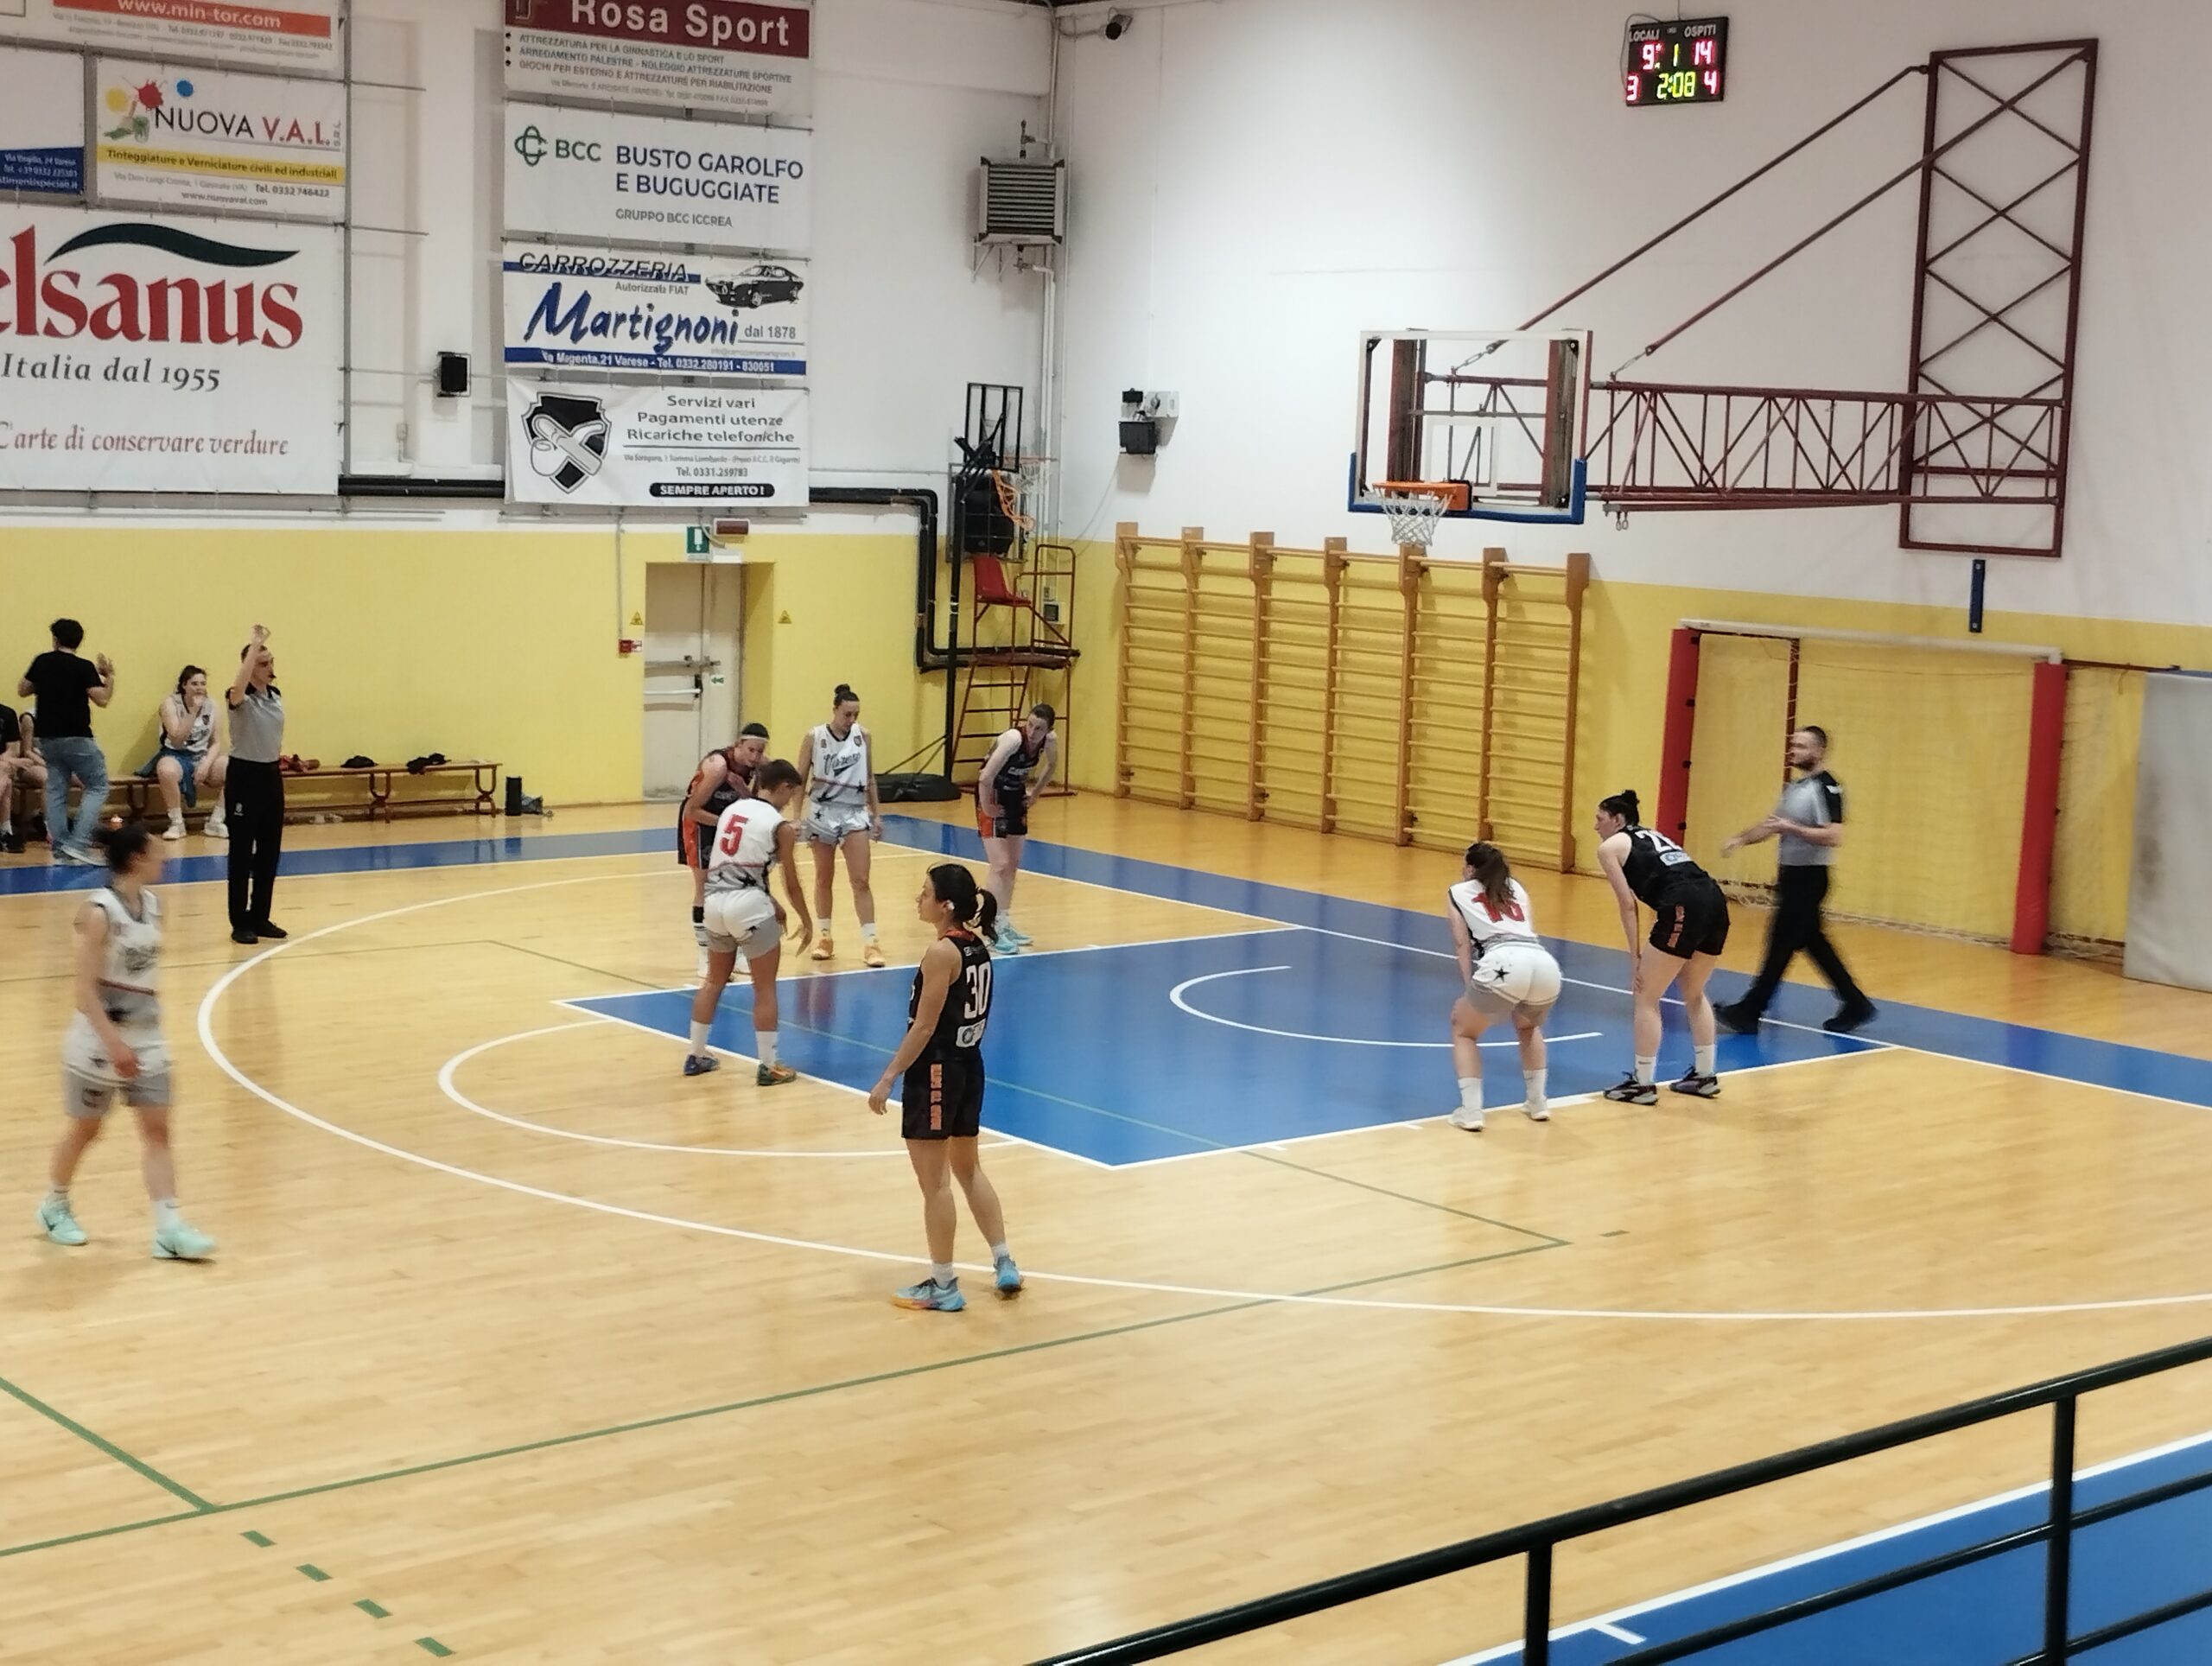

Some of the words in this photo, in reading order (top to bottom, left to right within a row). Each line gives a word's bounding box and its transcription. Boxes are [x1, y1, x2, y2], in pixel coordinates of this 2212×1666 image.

[572, 0, 668, 34] Rosa
[685, 3, 789, 46] Sport
[1629, 29, 1660, 42] LOCALI
[1684, 24, 1716, 37] OSPITI
[519, 35, 588, 49] ATTREZZATURA
[589, 42, 607, 52] PER
[610, 44, 620, 54] LA
[622, 46, 675, 60] GINNASTICA
[697, 54, 724, 65] SPORT
[519, 47, 588, 62] ARREDAMENTO
[590, 54, 633, 67] PALESTRE
[642, 60, 685, 73] NOLEGGIO
[687, 65, 751, 80] ATTREZZATURE
[753, 71, 791, 84] SPORTIVE
[1673, 43, 1679, 67] 1
[1694, 41, 1713, 66] 14
[519, 60, 551, 72] GIOCHI
[553, 64, 571, 73] PER
[573, 66, 614, 78] ESTERNO
[624, 71, 688, 86] ATTREZZATURE
[690, 77, 707, 87] PER
[709, 78, 772, 93] RIABILITAZIONE
[1626, 75, 1639, 101] 3
[1656, 71, 1696, 99] 2:08
[1704, 70, 1717, 95] 4
[155, 106, 254, 139] NUOVA
[107, 149, 176, 164] Tinteggiature
[188, 157, 248, 172] Verniciature
[250, 163, 272, 174] civili
[275, 166, 288, 175] ed
[289, 167, 337, 180] industriali
[555, 138, 602, 162] BCC
[616, 145, 692, 170] BUSTO
[698, 152, 804, 180] GAROLFO
[616, 173, 629, 193] E
[636, 174, 779, 205] BUGUGGIATE
[615, 208, 664, 223] GRUPPO
[666, 213, 690, 224] BCC
[692, 214, 733, 227] ICCREA
[519, 252, 690, 283] CARROZZERIA
[0, 225, 303, 350] lsanus
[669, 286, 690, 296] FIAT
[524, 282, 739, 355] Martignoni
[744, 324, 764, 339] dal
[767, 326, 797, 340] 1878
[1, 353, 92, 382] Italia
[103, 357, 151, 384] dal
[161, 366, 221, 392] 1955
[614, 354, 649, 367] Varese
[657, 357, 673, 368] Tel.
[667, 395, 721, 409] Servizi
[726, 397, 755, 410] vari
[638, 412, 725, 426] Pagamenti
[730, 415, 783, 427] utenze
[65, 423, 85, 450] di
[92, 435, 205, 454] conservare
[210, 429, 289, 455] verdure
[627, 429, 703, 442] Ricariche
[708, 430, 794, 443] telefoniche
[676, 467, 690, 476] Tel.
[660, 486, 709, 496] SEMPRE
[720, 814, 748, 856] 5
[964, 962, 991, 1020] 30
